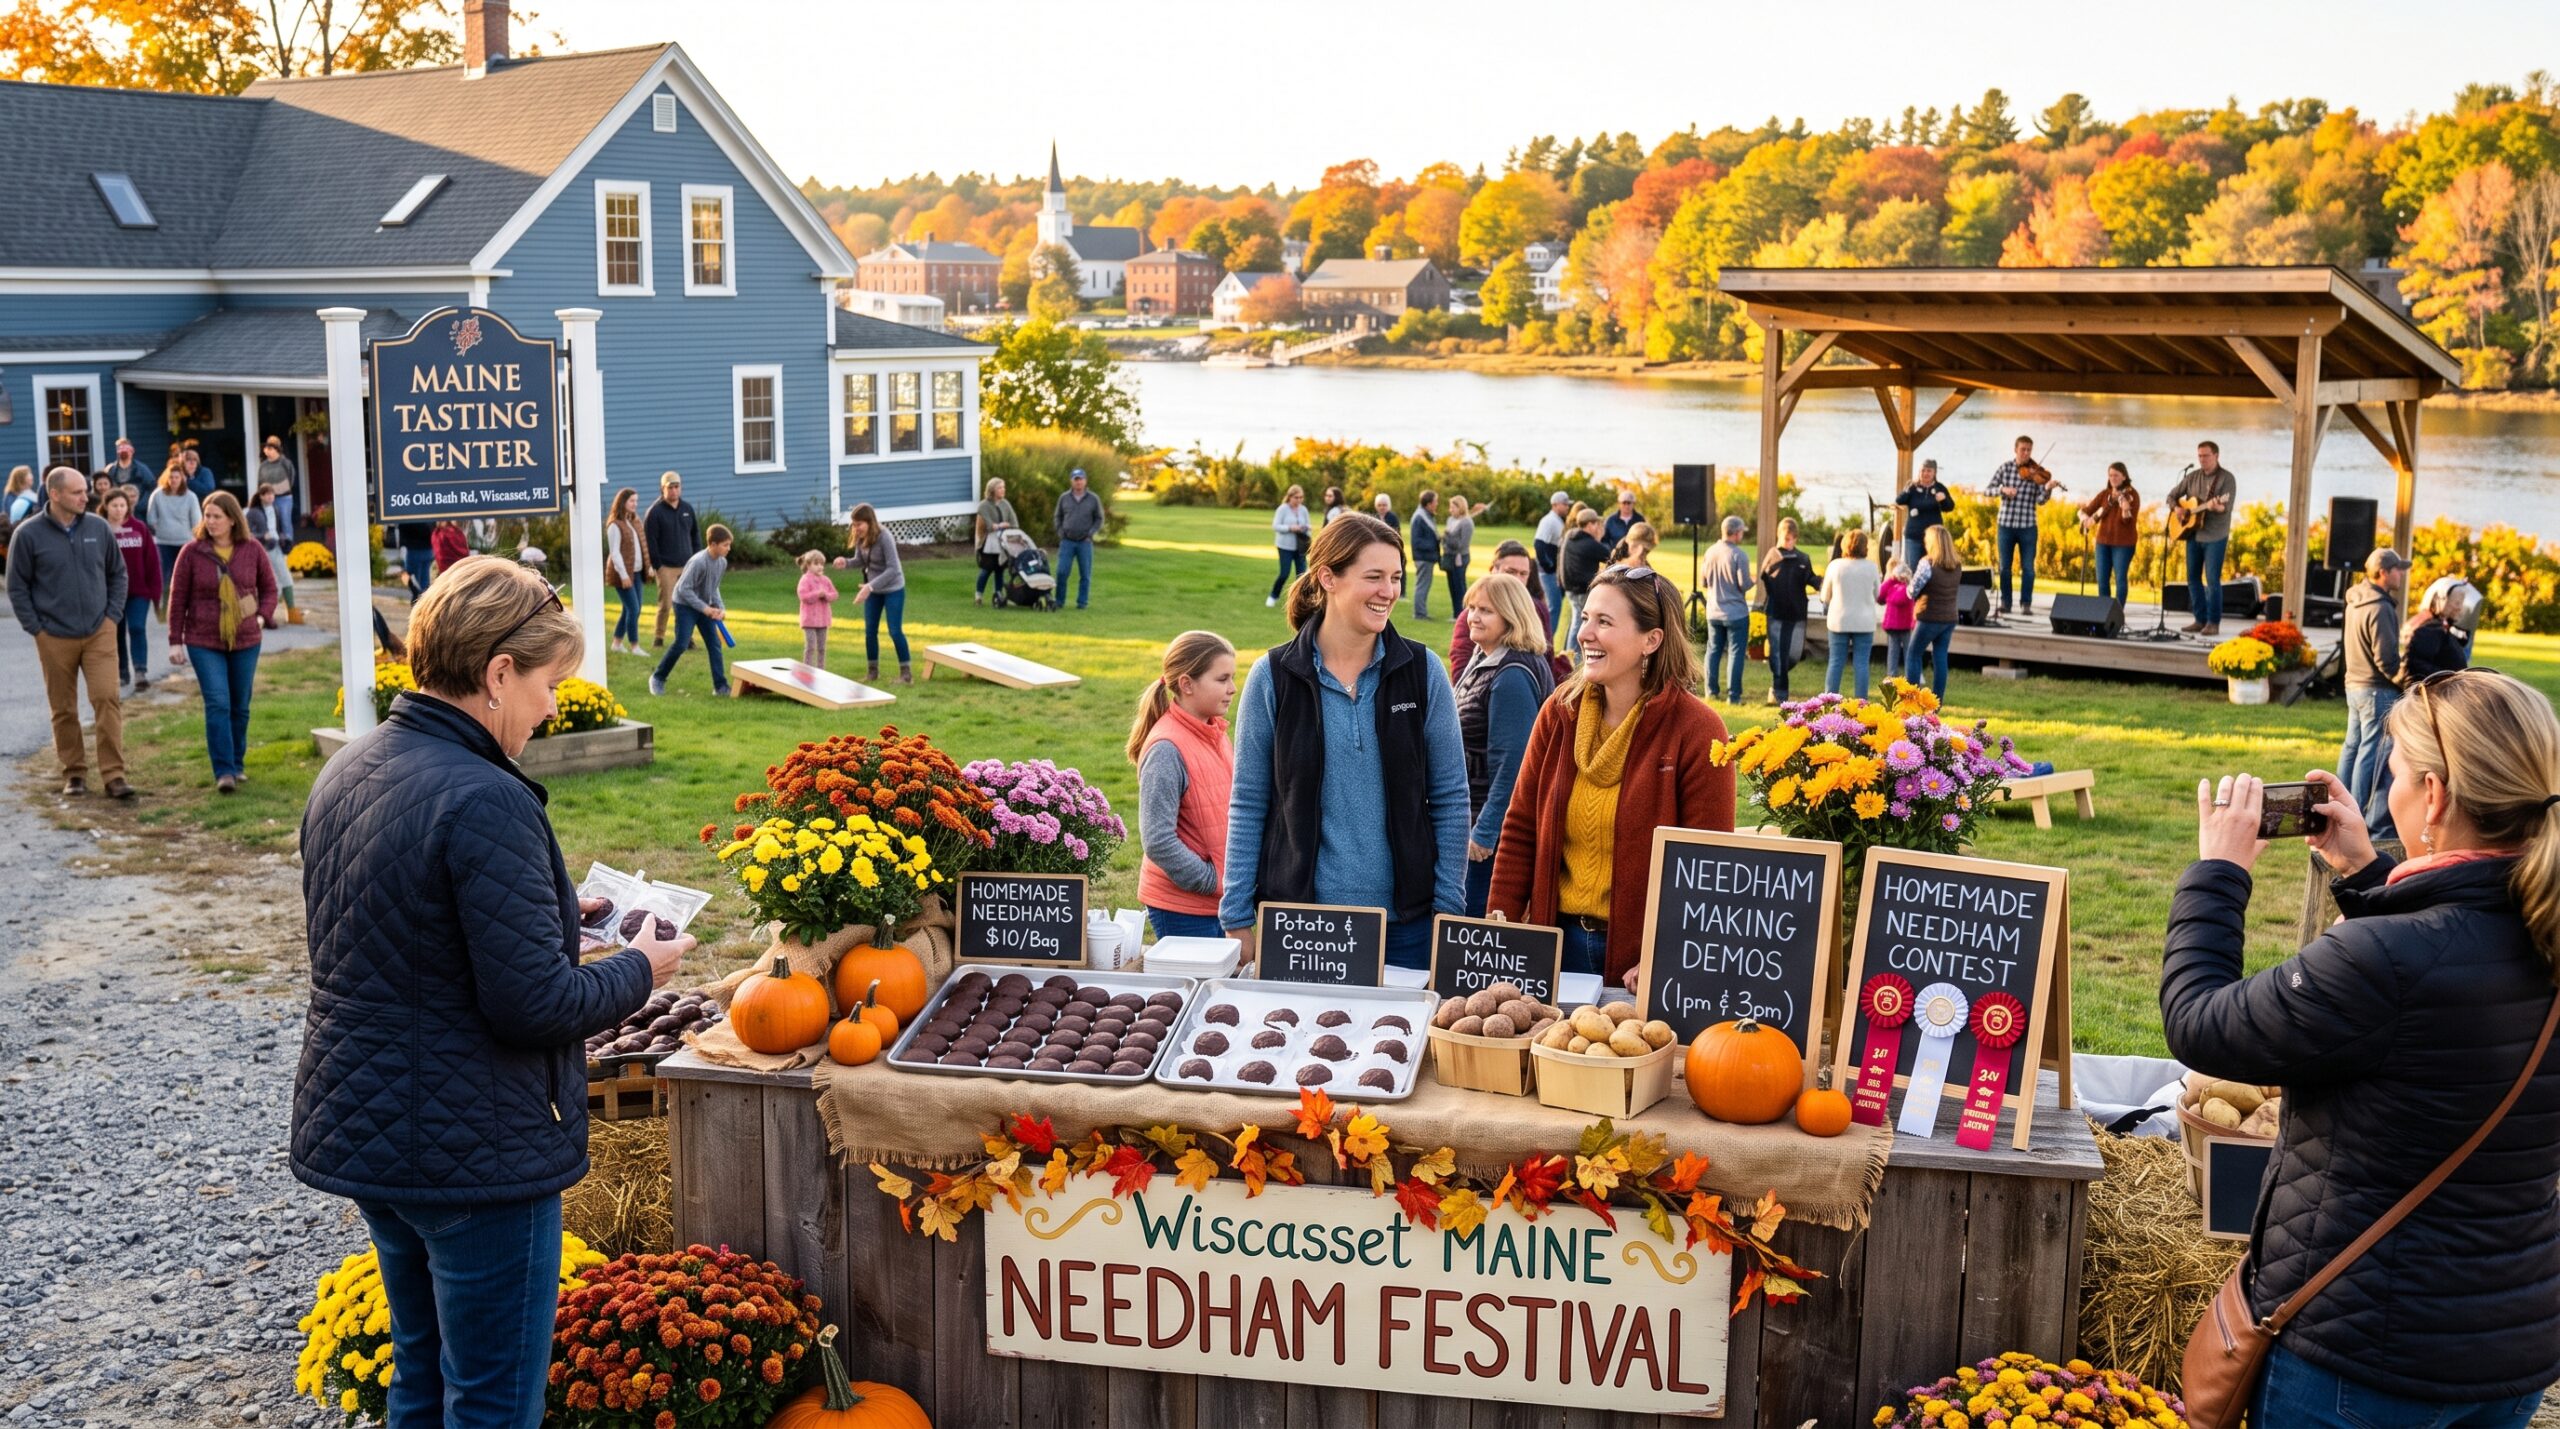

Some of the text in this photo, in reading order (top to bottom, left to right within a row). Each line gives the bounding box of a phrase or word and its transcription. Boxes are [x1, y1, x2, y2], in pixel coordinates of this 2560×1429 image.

[410, 363, 521, 393] MAINE
[393, 401, 539, 432] TASTING
[402, 440, 538, 472] CENTER
[390, 493, 411, 507] 506
[412, 492, 433, 506] Old
[434, 490, 458, 505] Bath
[460, 490, 478, 504] Rd,
[479, 488, 531, 502] Wiscasset,
[971, 881, 1070, 902] HOMEMADE
[1675, 856, 1814, 903] NEEDHAM
[1884, 874, 2037, 919] HOMEMADE
[972, 903, 1073, 923] NEEDHAMS
[1275, 911, 1335, 933] Potato
[1682, 901, 1797, 942] MAKING
[985, 926, 1059, 957] $10/Bag
[1282, 934, 1358, 953] Coconut
[1446, 926, 1507, 949] LOCAL
[1886, 909, 2020, 955] NEEDHAM
[1289, 953, 1347, 980] Filling
[1464, 949, 1528, 973] MAINE
[1682, 940, 1783, 981] DEMOS
[1888, 944, 2017, 987] CONTEST
[1133, 1191, 1613, 1286] Wiscasset MAINE
[1001, 1255, 1710, 1395] NEEDHAM FESTIVAL
